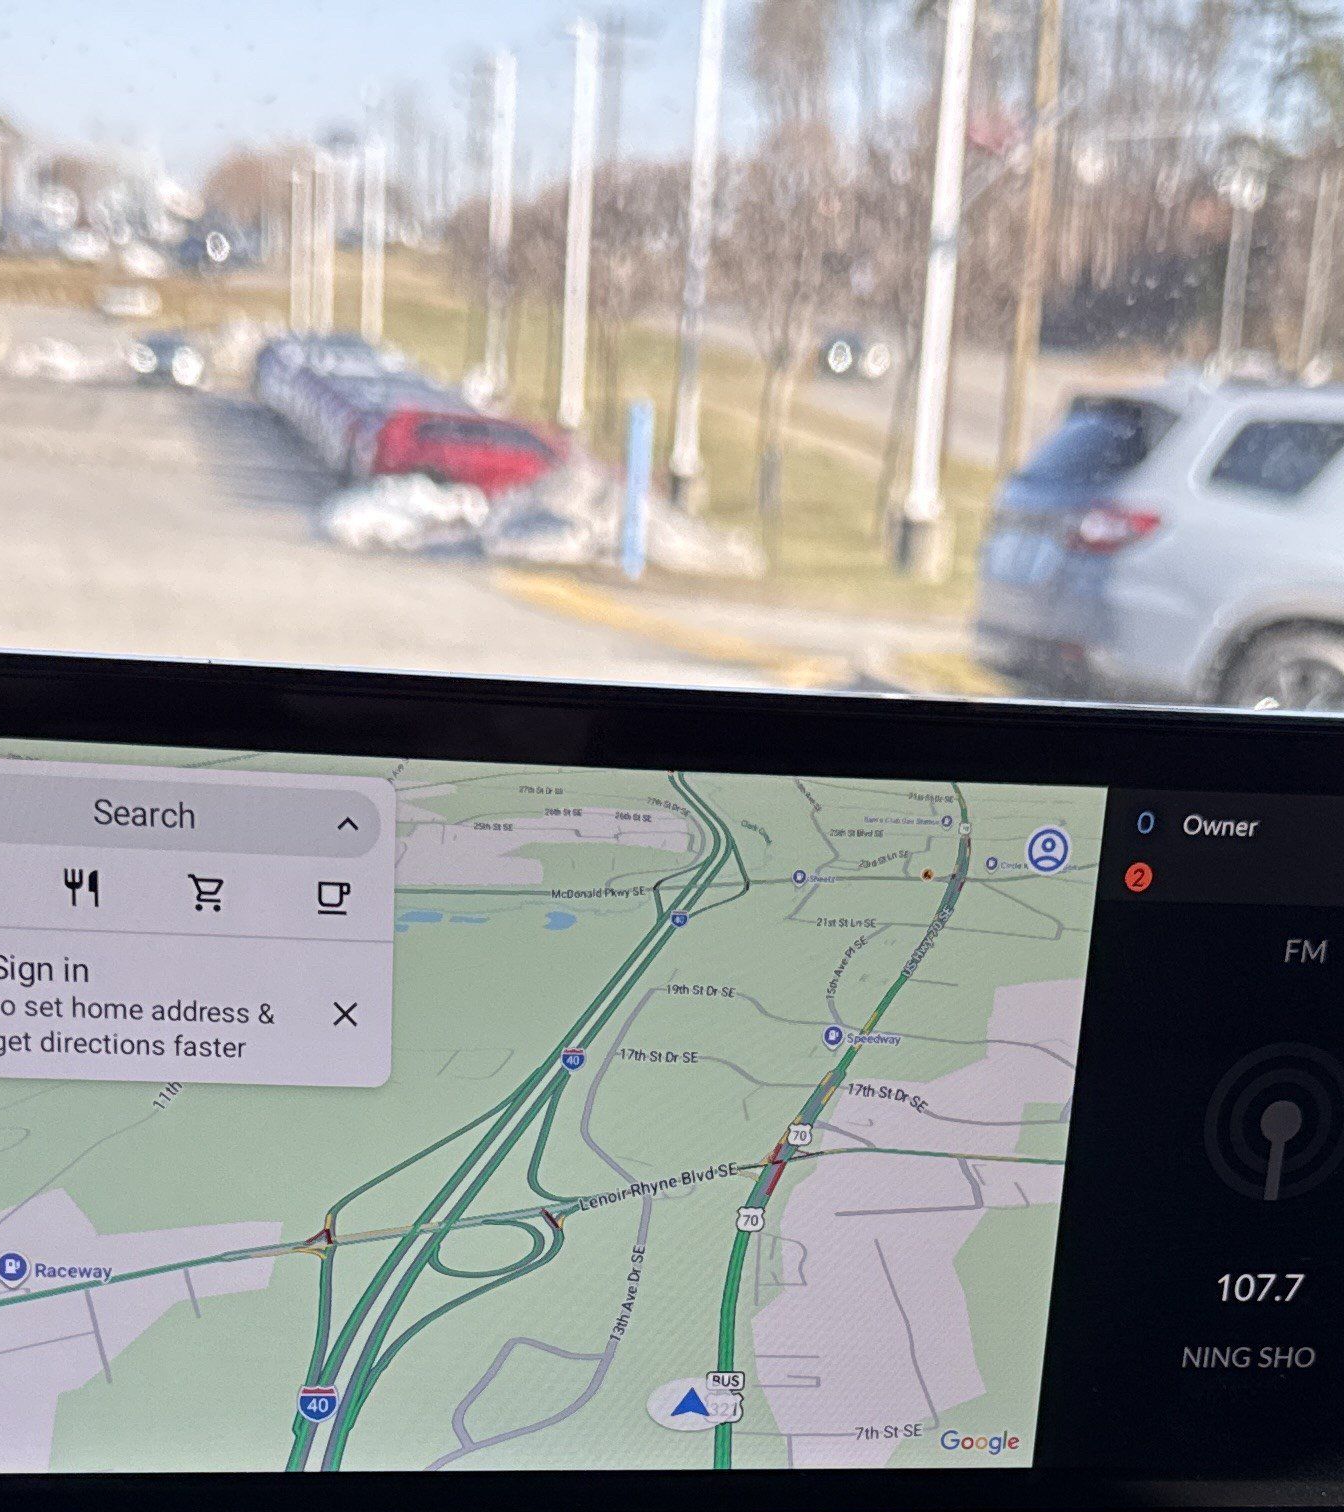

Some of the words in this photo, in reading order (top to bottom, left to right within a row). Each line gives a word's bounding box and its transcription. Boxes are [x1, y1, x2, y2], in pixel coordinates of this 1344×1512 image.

[93, 799, 196, 829] Search
[1182, 813, 1259, 839] Owner
[1131, 867, 1147, 888] 2
[551, 887, 602, 899] McDonald
[604, 887, 630, 900] Pkwy
[632, 887, 646, 897] SE
[816, 917, 838, 928] 21st
[838, 918, 849, 928] St
[850, 918, 863, 928] Ln
[863, 918, 876, 929] SE
[833, 958, 849, 978] Ave
[853, 934, 868, 951] SE
[1283, 938, 1328, 964] FM
[63, 956, 90, 983] in
[666, 984, 695, 997] 19th
[698, 984, 709, 996] St
[710, 985, 721, 997] Dr
[721, 986, 736, 998] SE
[24, 997, 63, 1018] set
[71, 997, 144, 1021] home
[151, 999, 250, 1025] address
[258, 1003, 275, 1025] &
[40, 1031, 166, 1058] directions
[174, 1033, 247, 1060] faster
[846, 1033, 901, 1046] Speedway
[565, 1054, 580, 1067] 40
[620, 1048, 650, 1062] 17th
[652, 1048, 664, 1062] St
[666, 1050, 681, 1062] Dr
[682, 1050, 699, 1063] SE
[152, 1079, 183, 1111] 11th
[847, 1083, 876, 1098] 17th
[877, 1085, 893, 1099] St
[894, 1088, 910, 1102] Dr
[908, 1095, 929, 1114] SE
[791, 1129, 808, 1143] 70
[680, 1165, 715, 1186] Blvd
[717, 1161, 739, 1178] SE
[741, 1213, 759, 1228] 70
[630, 1244, 647, 1265] SE
[34, 1262, 113, 1283] Raceway
[626, 1269, 642, 1283] Dr
[621, 1285, 638, 1312] Ave
[1217, 1273, 1306, 1302] 107.7
[609, 1314, 631, 1343] 13th
[1180, 1344, 1251, 1370] NING
[1257, 1345, 1317, 1370] SHO
[712, 1374, 740, 1388] BUS
[306, 1397, 329, 1413] 40
[854, 1425, 879, 1441] 7th
[882, 1425, 900, 1440] St
[901, 1423, 923, 1439] SE
[940, 1429, 1021, 1456] Google
